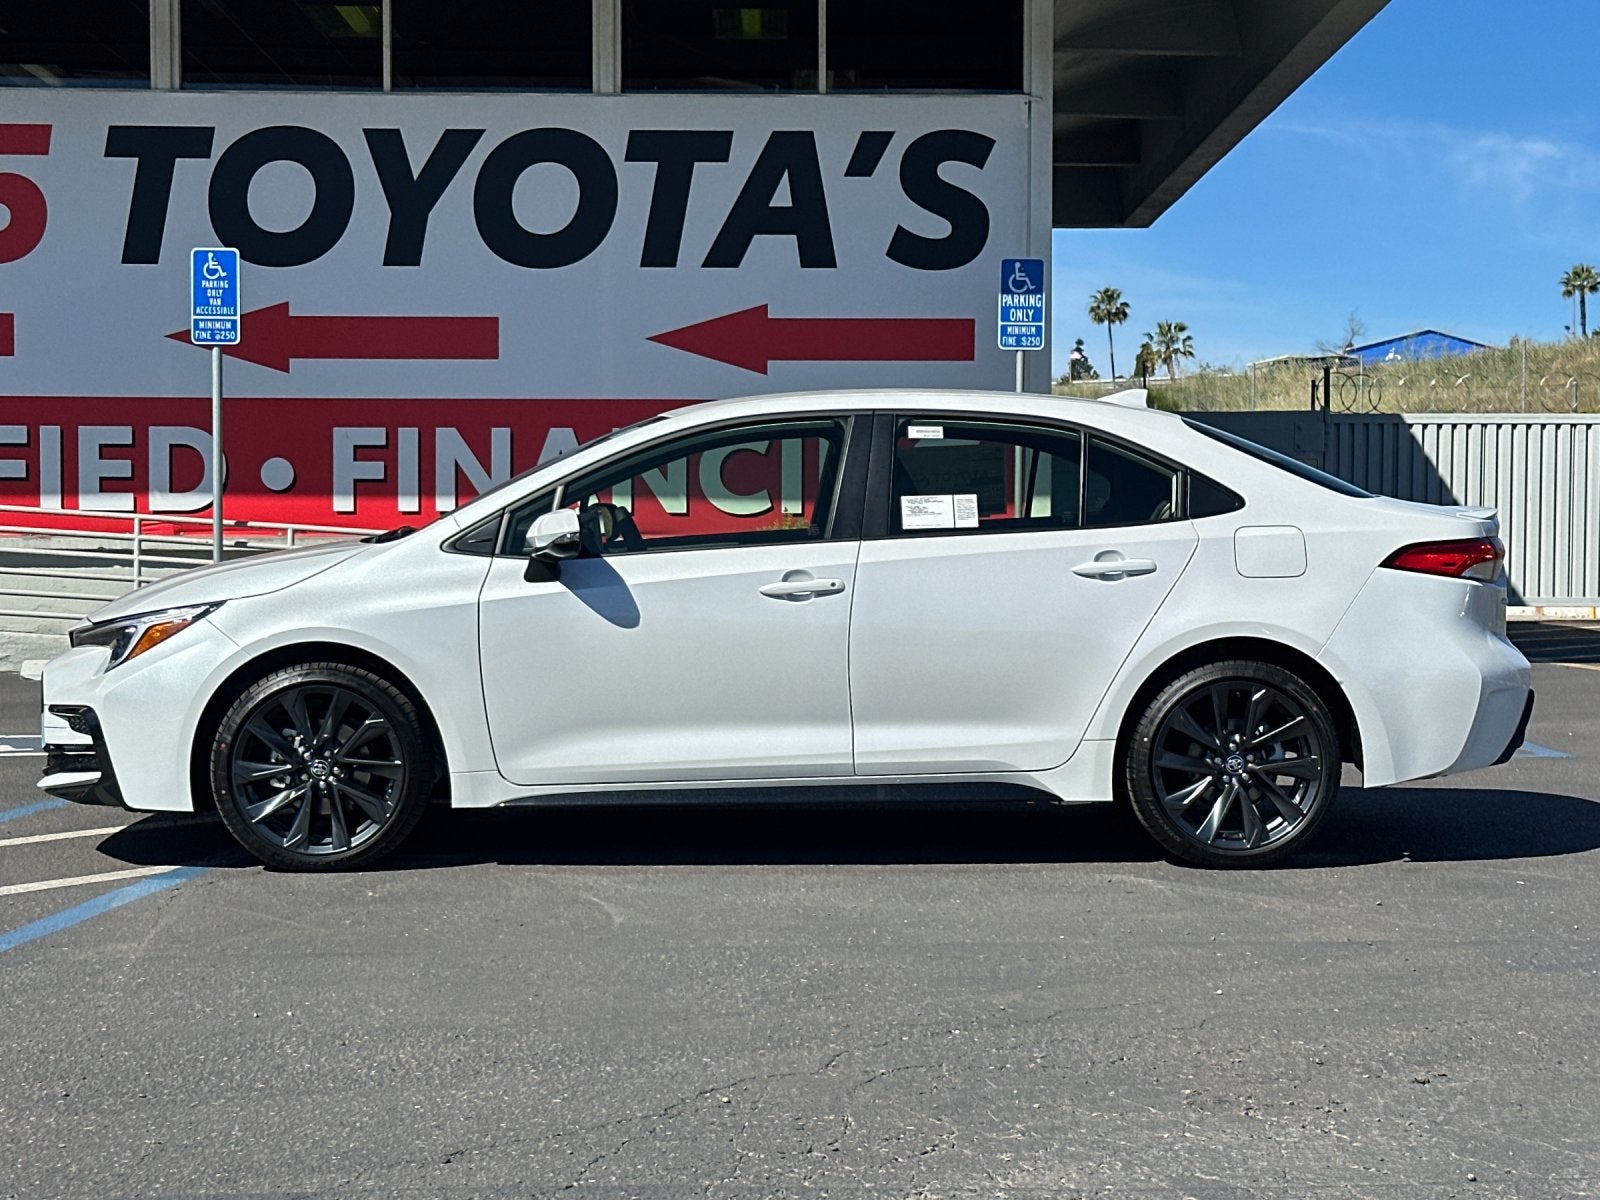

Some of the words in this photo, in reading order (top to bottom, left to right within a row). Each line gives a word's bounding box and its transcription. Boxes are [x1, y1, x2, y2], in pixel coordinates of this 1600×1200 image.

[104, 125, 996, 270] TOYOTA'S
[201, 280, 229, 288] PARKING
[209, 298, 221, 306] VAN
[1002, 293, 1042, 307] PARKING
[196, 306, 235, 315] ACCESSIBLE
[1010, 308, 1034, 322] ONLY
[199, 321, 232, 330] MINIMUM
[1007, 325, 1036, 335] MINIMUM
[195, 330, 212, 339] FINE
[1002, 336, 1017, 345] FINE
